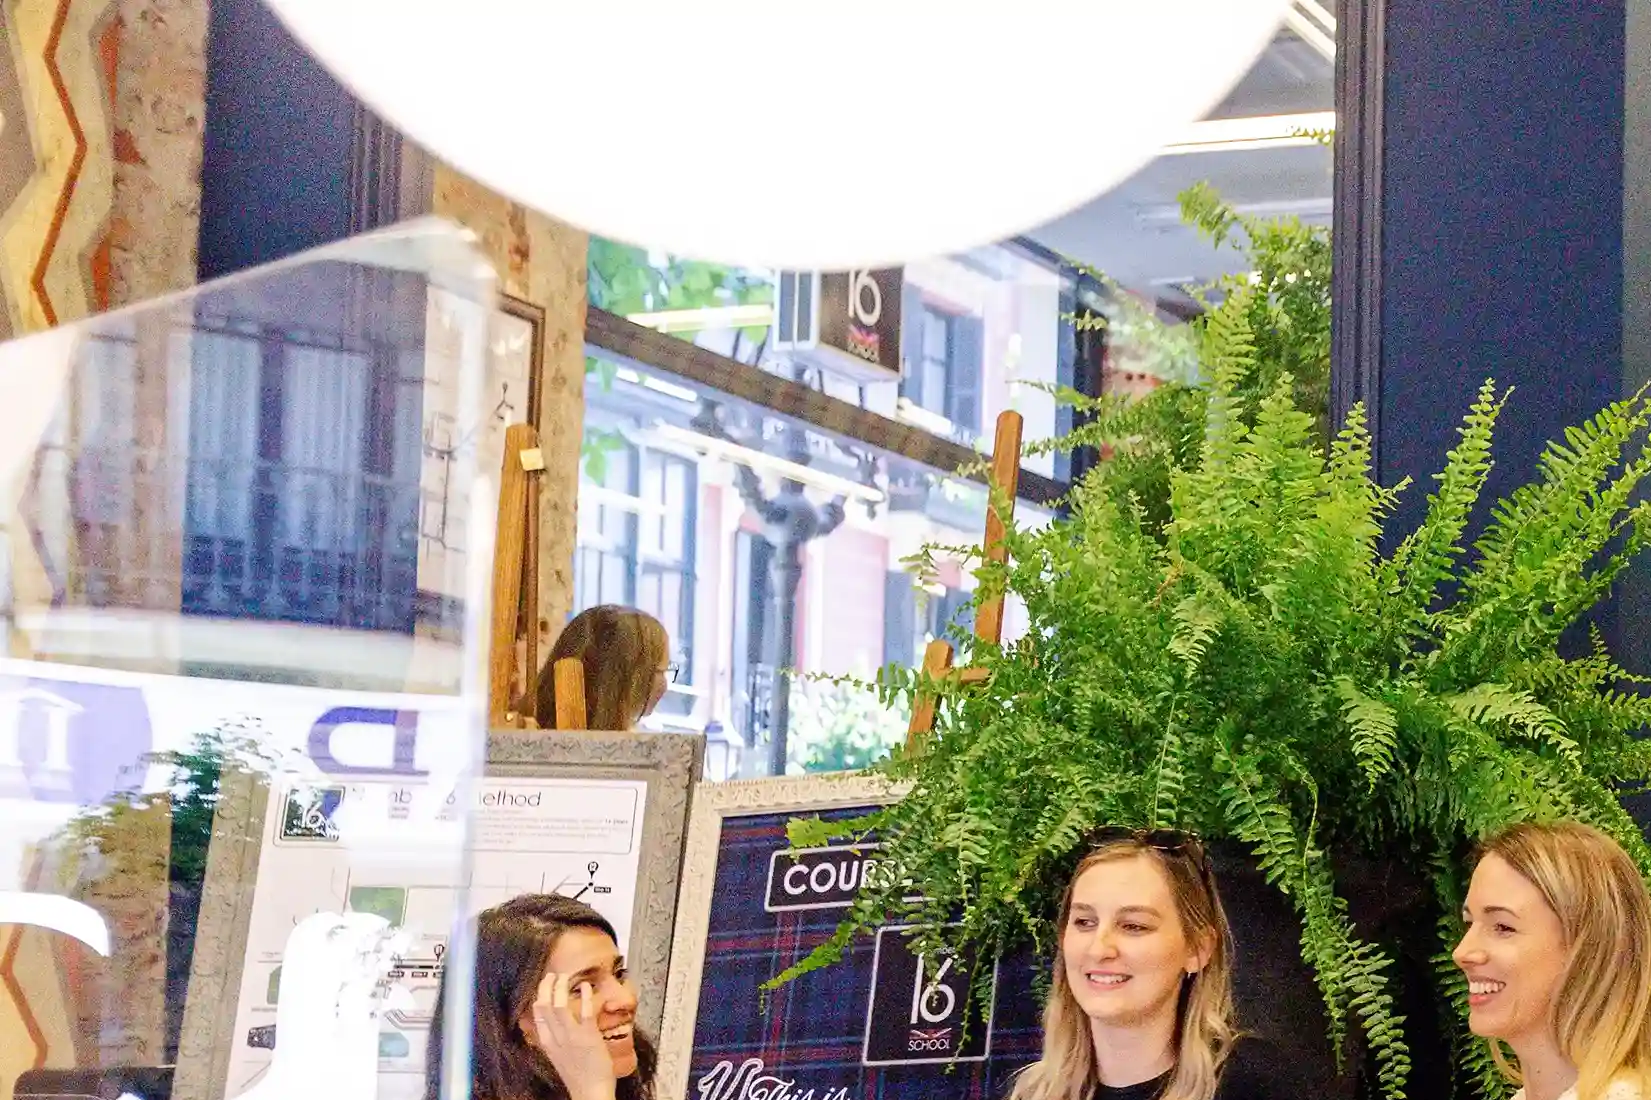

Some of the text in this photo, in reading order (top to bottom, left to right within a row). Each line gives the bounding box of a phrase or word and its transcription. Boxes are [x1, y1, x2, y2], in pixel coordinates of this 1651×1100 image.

[848, 268, 882, 326] 16
[479, 790, 542, 807] ethod
[910, 951, 955, 1024] 16
[908, 1038, 950, 1051] SCHOOL
